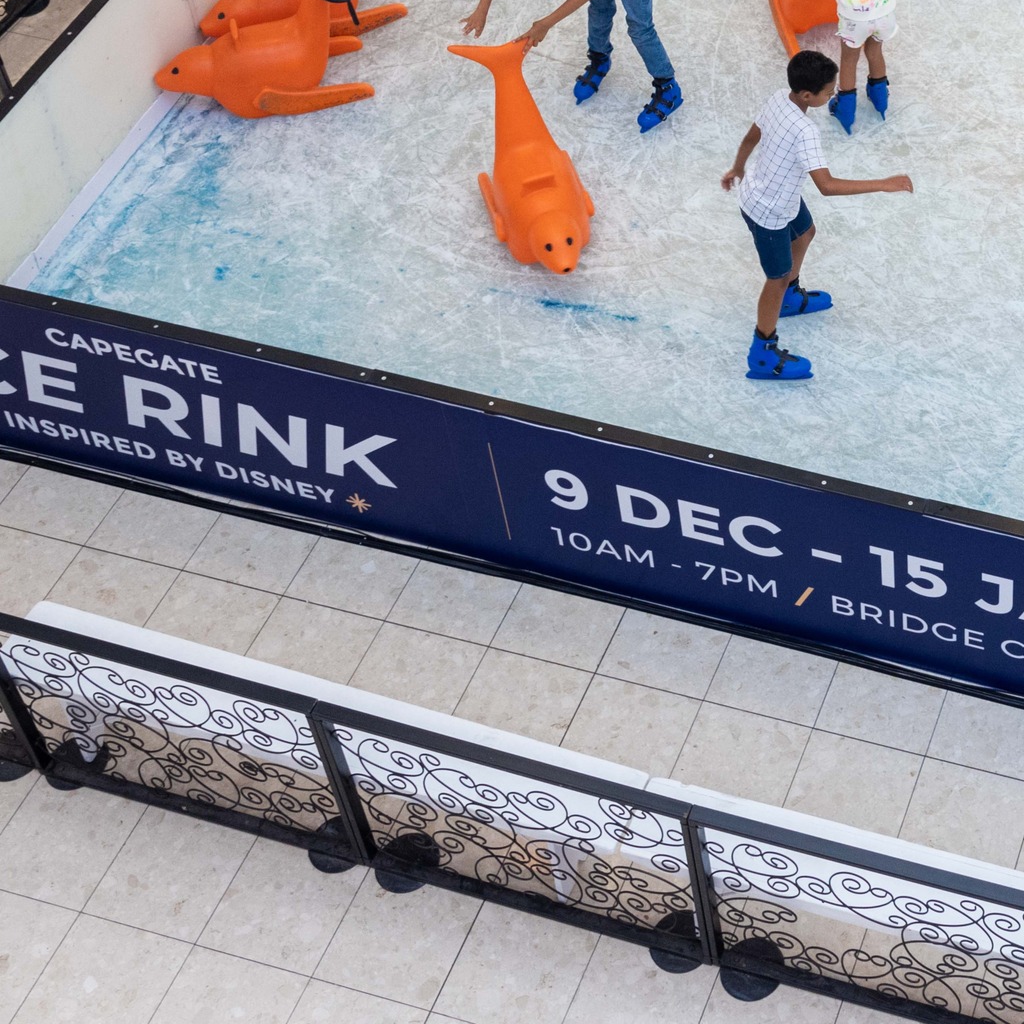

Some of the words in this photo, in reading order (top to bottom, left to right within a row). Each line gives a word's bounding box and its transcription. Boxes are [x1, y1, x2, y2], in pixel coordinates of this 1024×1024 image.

[44, 327, 223, 385] CAPEGATE
[3, 410, 156, 460] INSPIRED
[165, 448, 204, 472] BY
[214, 461, 335, 504] DISNEY
[123, 374, 398, 489] RINK
[544, 469, 589, 511] 9
[615, 484, 784, 558] DEC
[868, 545, 948, 598] 15
[550, 526, 655, 568] 10AM
[694, 560, 778, 598] 7PM
[831, 595, 986, 651] BRIDGE
